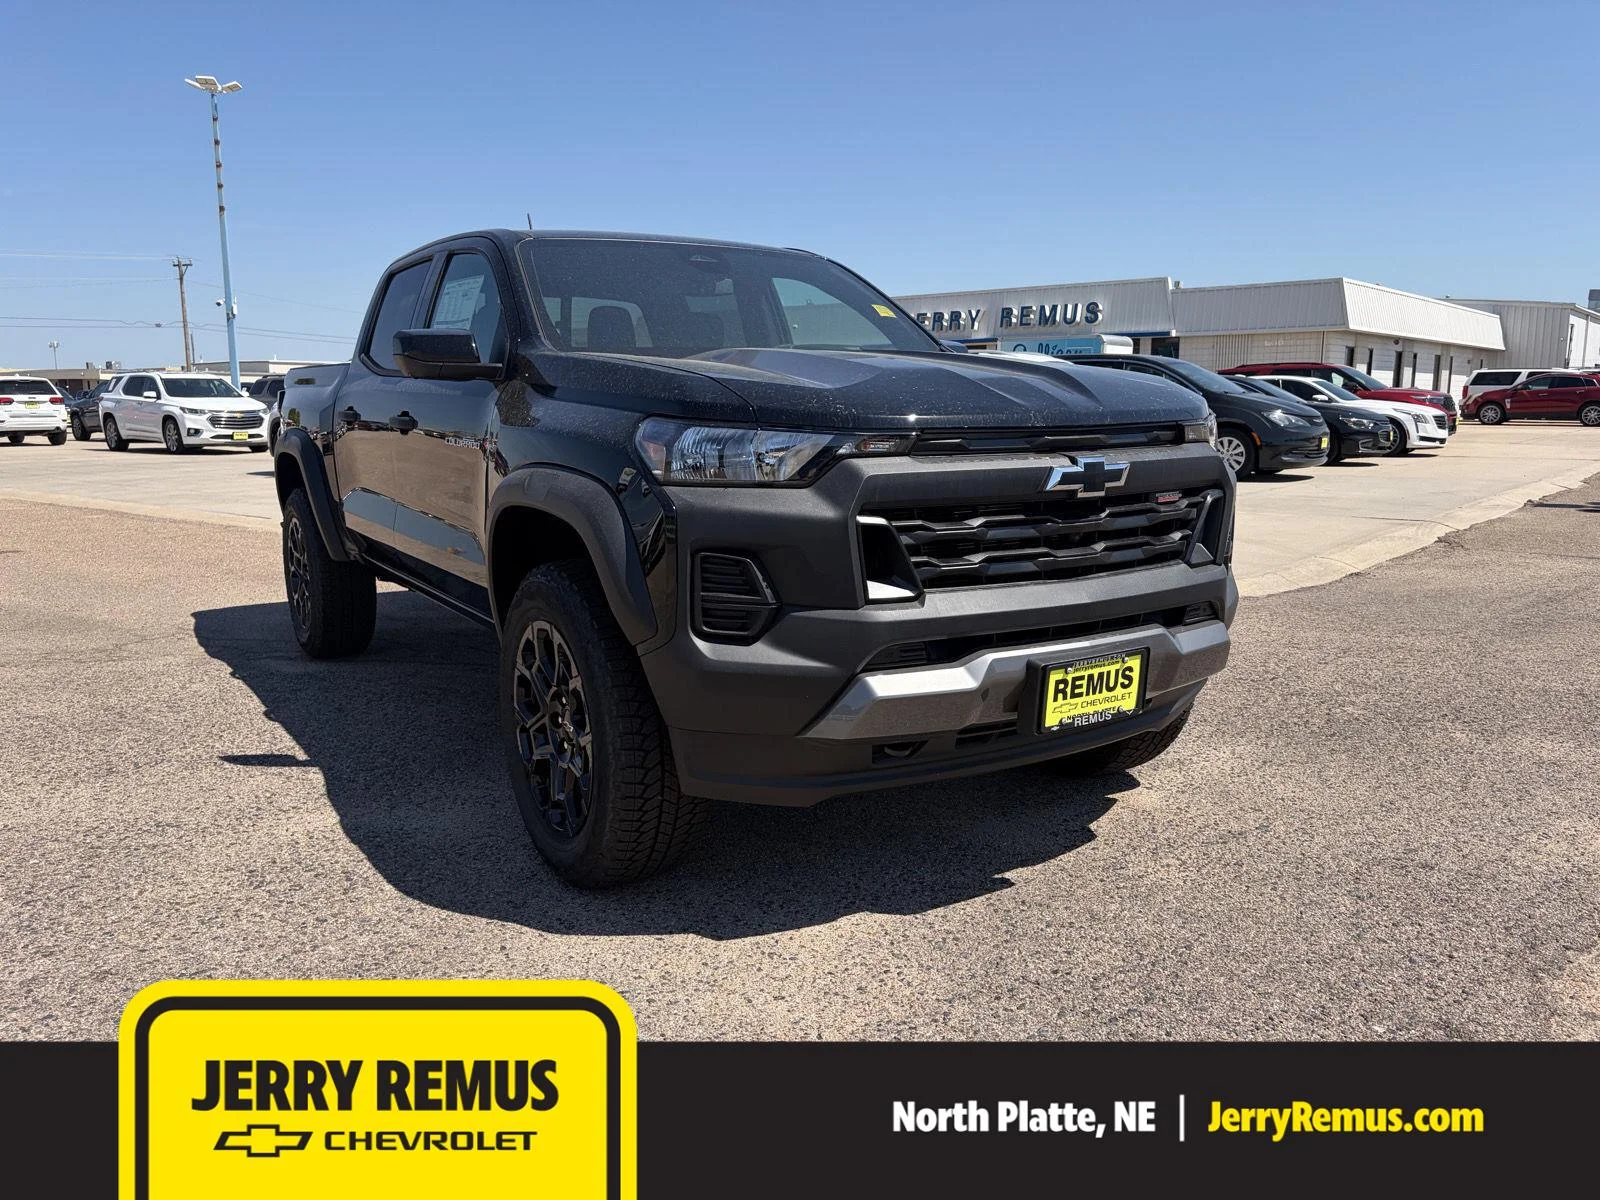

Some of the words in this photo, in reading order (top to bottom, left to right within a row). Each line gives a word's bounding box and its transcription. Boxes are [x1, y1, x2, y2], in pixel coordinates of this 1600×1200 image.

[915, 309, 983, 331] ERRY
[1000, 302, 1102, 328] REMUS
[1053, 666, 1134, 702] REMUS
[1080, 692, 1133, 708] CHEVROLET
[1074, 712, 1112, 727] REMUS
